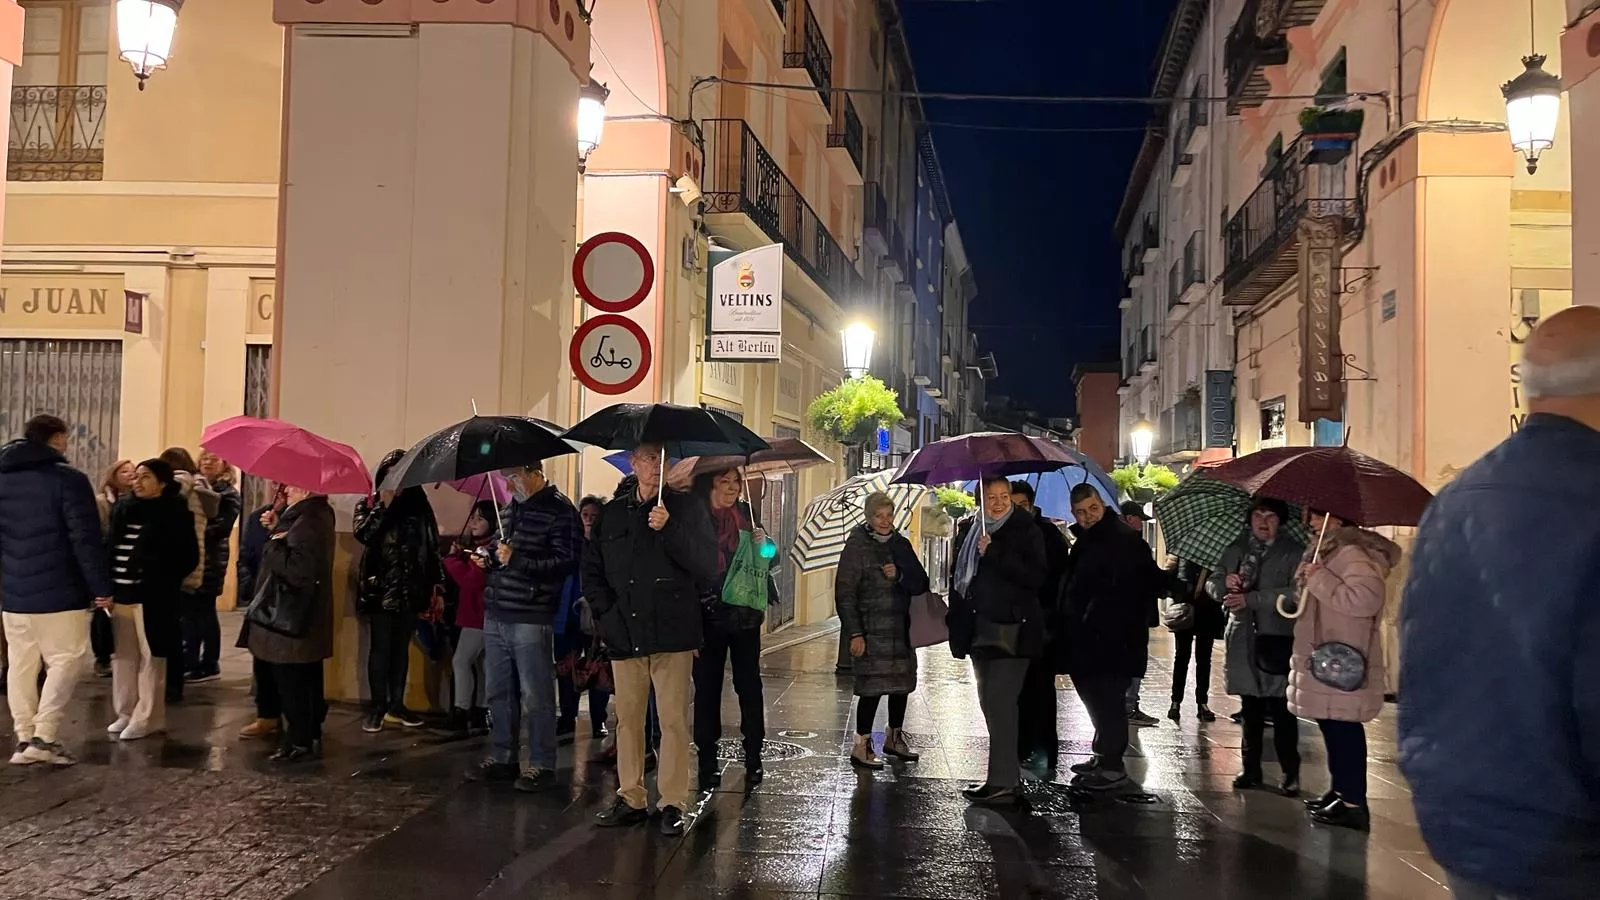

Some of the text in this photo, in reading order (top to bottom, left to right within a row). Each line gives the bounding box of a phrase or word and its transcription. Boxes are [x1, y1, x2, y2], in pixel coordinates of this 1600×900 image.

[22, 287, 108, 314] JUAN
[720, 294, 772, 307] VELTINS
[715, 340, 775, 353] Alt Berlin
